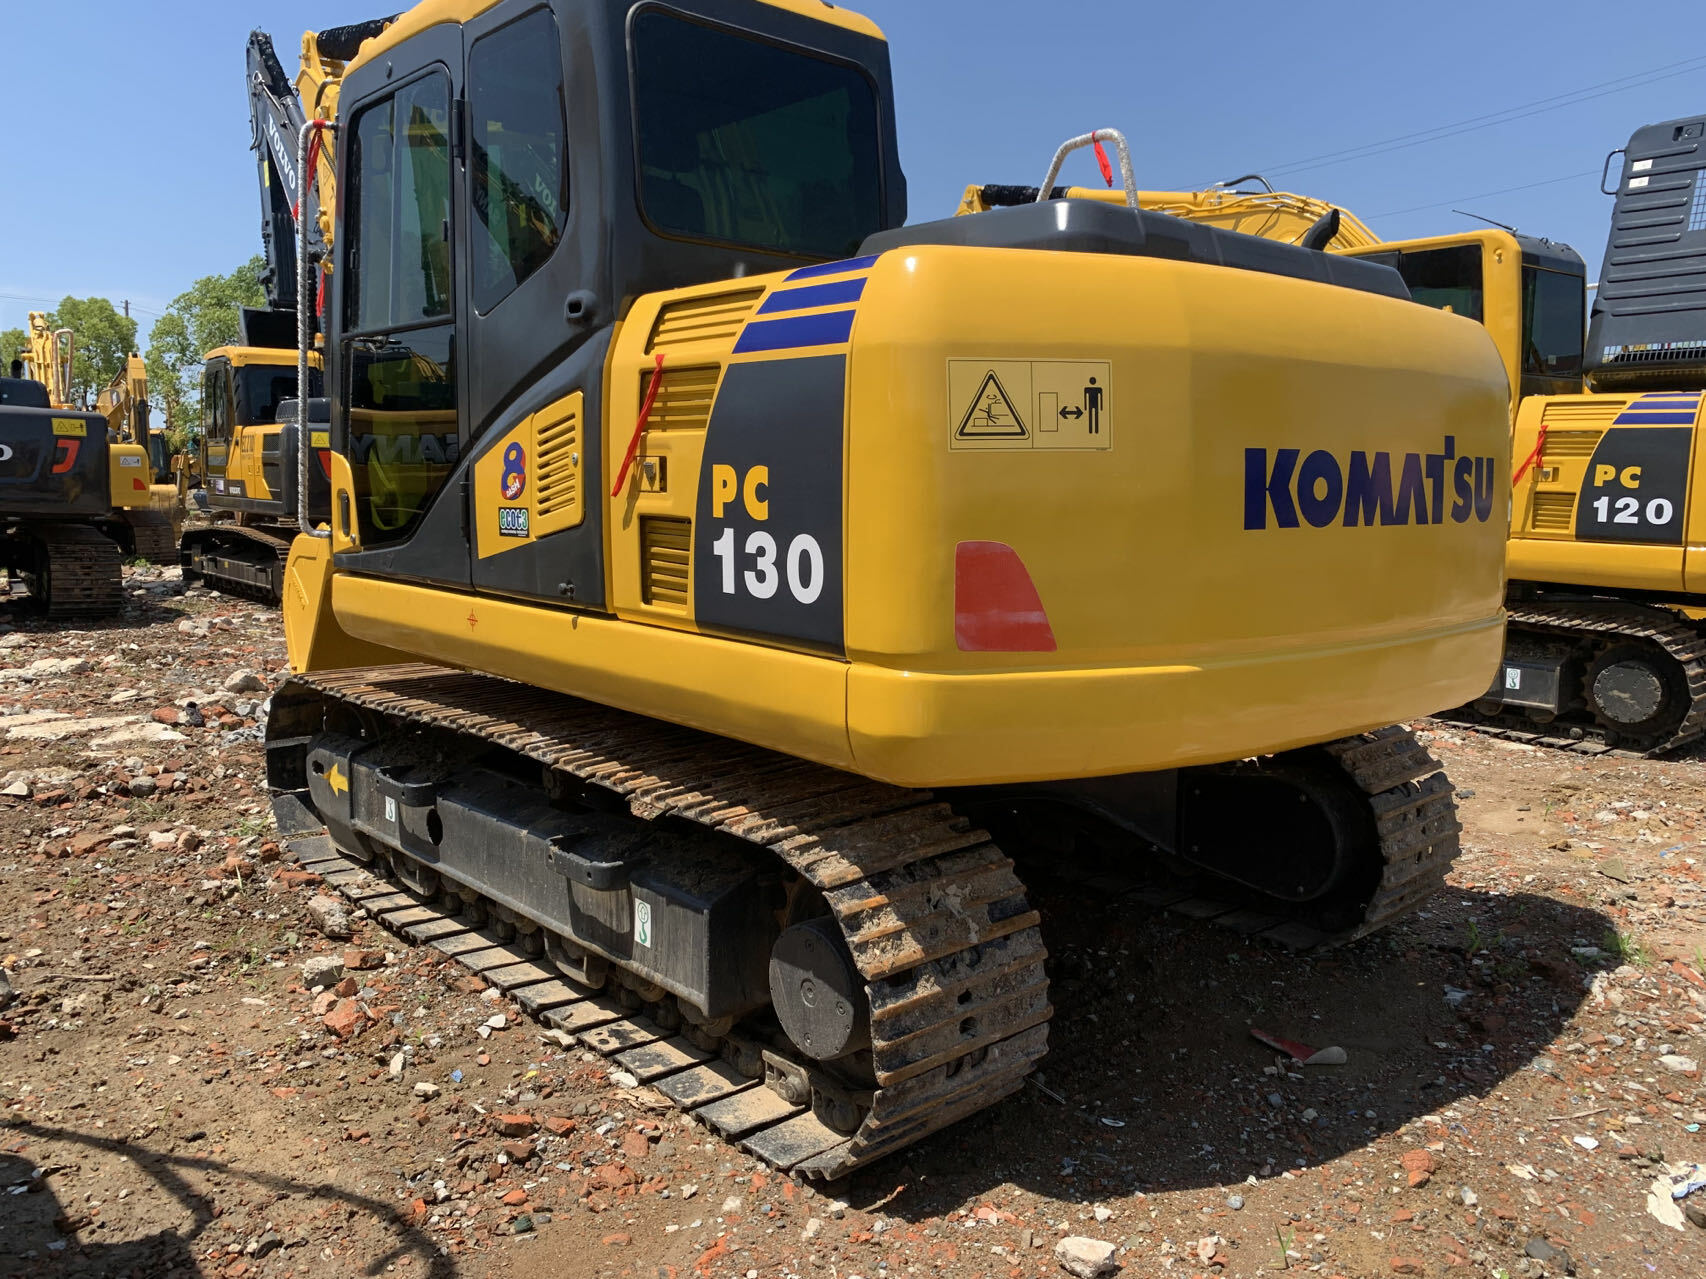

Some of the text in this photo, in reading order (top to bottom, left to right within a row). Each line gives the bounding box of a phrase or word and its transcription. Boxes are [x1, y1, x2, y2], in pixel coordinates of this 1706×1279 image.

[268, 113, 296, 190] VOLVO
[712, 464, 769, 521] PC
[1244, 435, 1495, 530] KOMATSU
[1593, 464, 1642, 489] PC
[1593, 496, 1674, 525] 120
[713, 527, 824, 604] 130
